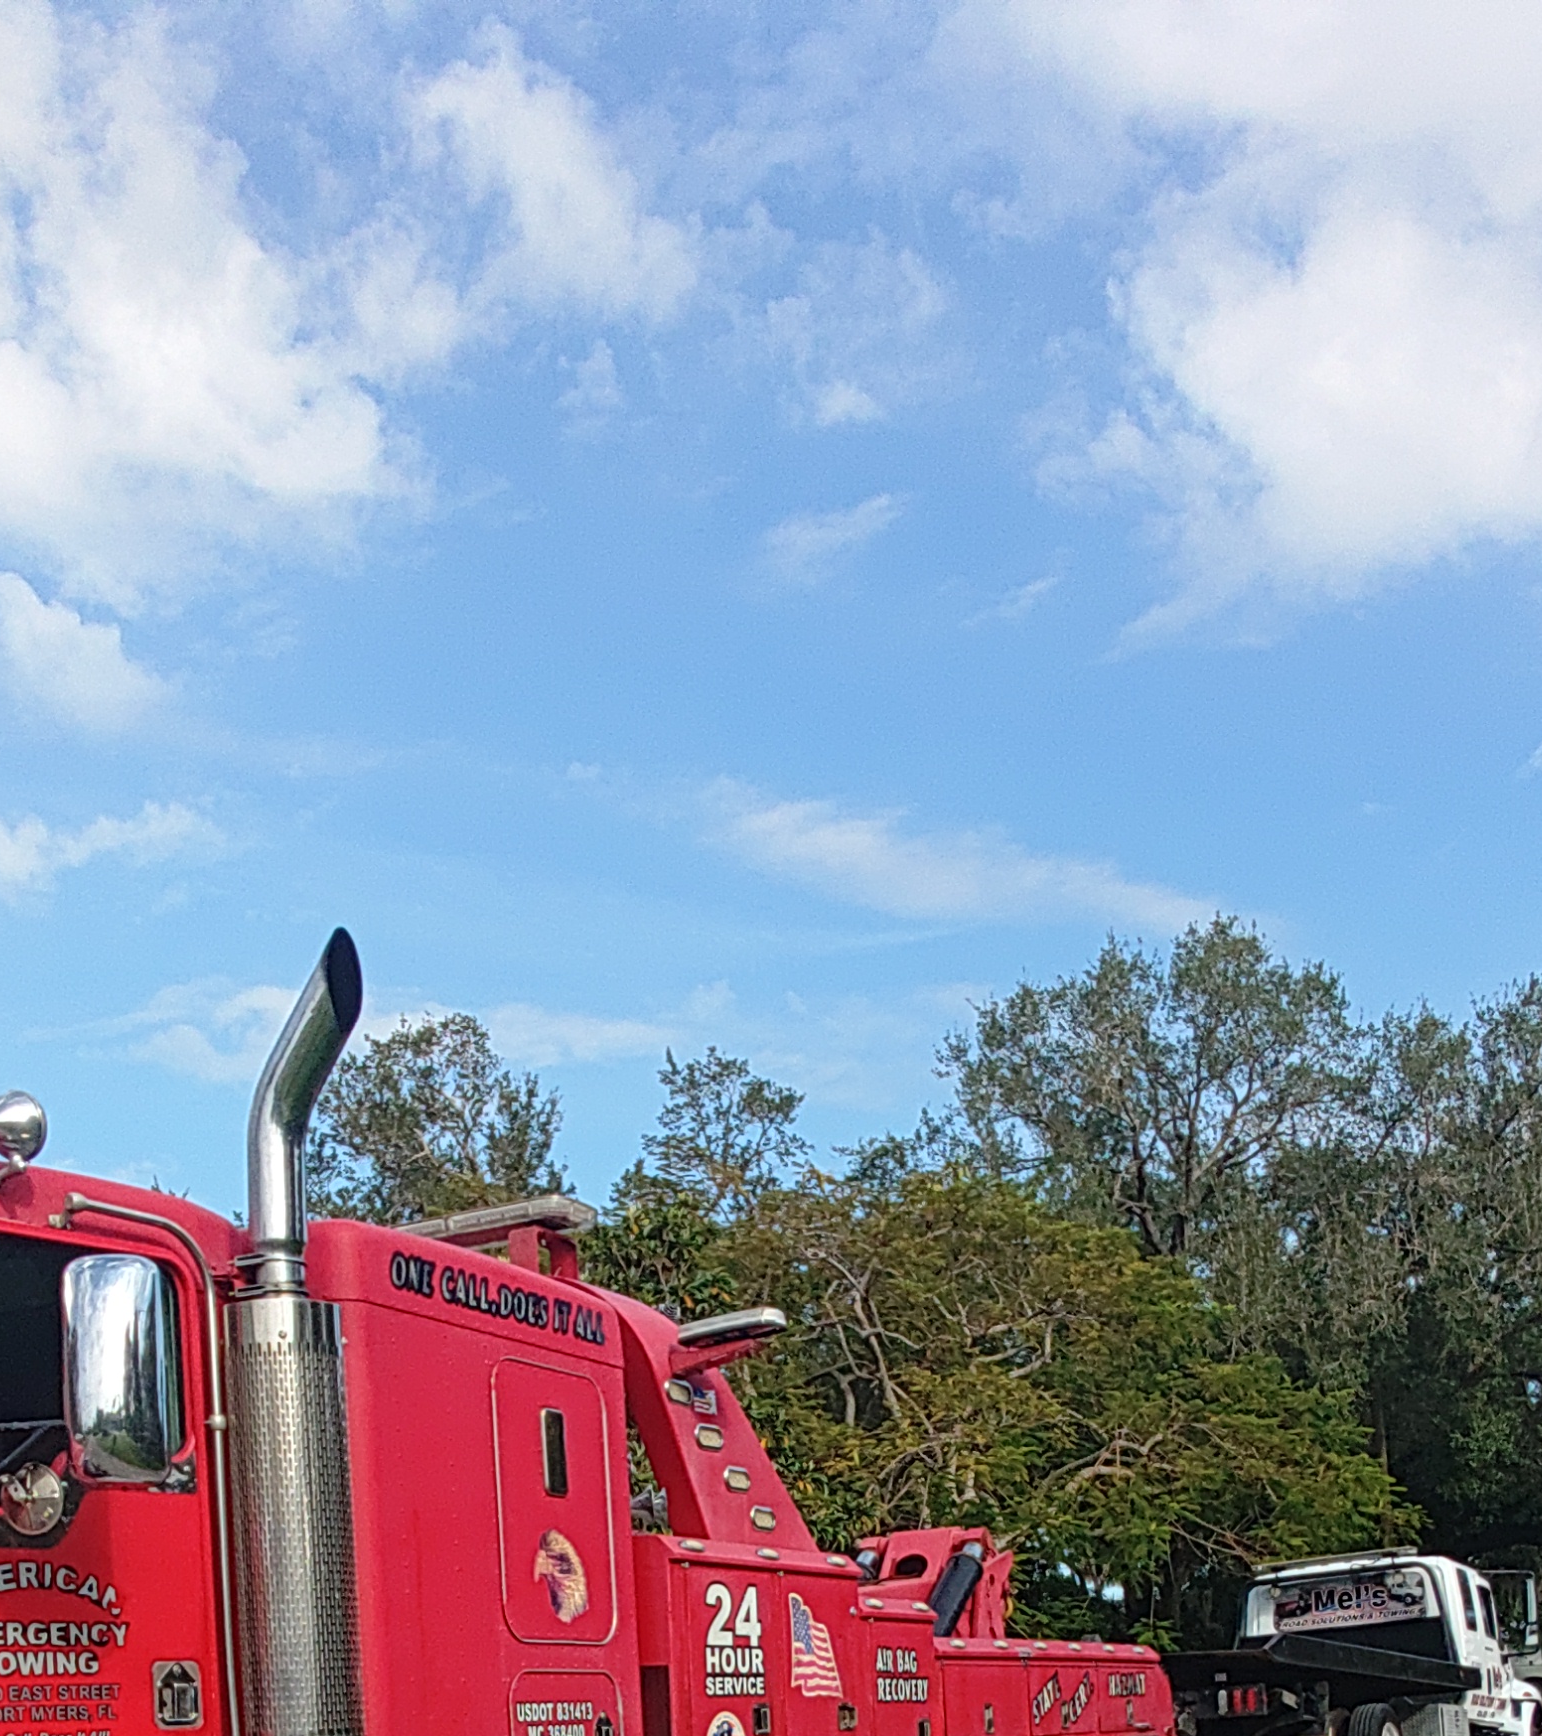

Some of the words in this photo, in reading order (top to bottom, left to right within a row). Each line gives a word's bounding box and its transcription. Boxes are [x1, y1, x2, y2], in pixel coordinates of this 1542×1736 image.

[390, 1254, 434, 1296] ONE
[500, 1288, 548, 1328] DOES
[553, 1300, 571, 1333] IT
[575, 1305, 605, 1344] ALL
[1313, 1585, 1388, 1612] Mel's
[706, 1583, 762, 1646] 24
[705, 1648, 764, 1674] HOUR
[876, 1649, 894, 1673] AIR
[897, 1650, 917, 1673] BAG
[8, 1686, 52, 1701] EAST
[58, 1684, 120, 1700] STREET
[705, 1677, 765, 1695] SERVICE
[877, 1678, 928, 1701] RECOVERY
[1109, 1673, 1146, 1696] HAZMAT
[1033, 1671, 1061, 1724] STATE
[31, 1704, 94, 1721] MYERS,
[97, 1703, 117, 1720] FL
[516, 1705, 554, 1722] USDOT
[557, 1702, 593, 1720] 831413
